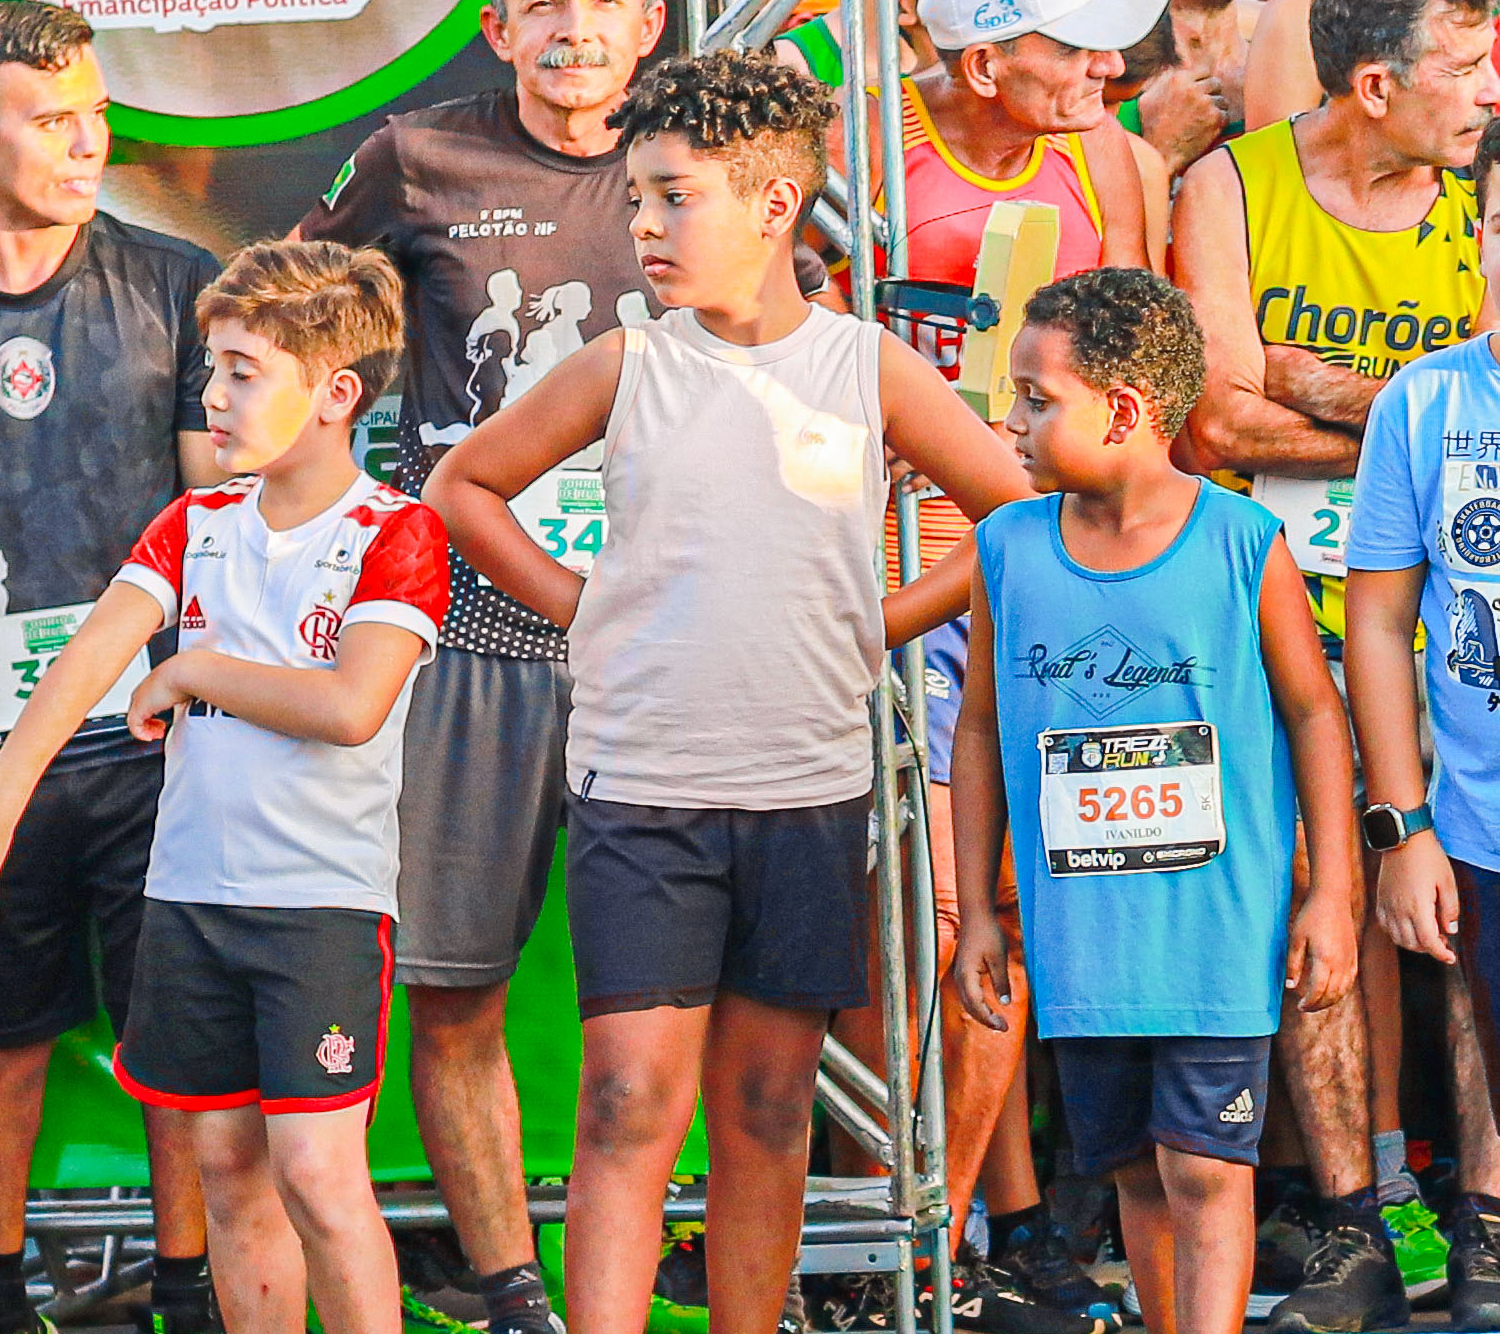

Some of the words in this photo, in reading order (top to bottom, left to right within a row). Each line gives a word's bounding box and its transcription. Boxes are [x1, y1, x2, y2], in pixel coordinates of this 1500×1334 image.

[448, 220, 528, 239] PELOTÃO
[1309, 508, 1346, 548] 2
[11, 656, 59, 700] 3
[1102, 647, 1198, 691] Legends
[1101, 734, 1172, 753] TREZE
[1102, 751, 1151, 769] RUN
[1078, 782, 1184, 823] 5265
[1104, 826, 1163, 841] IVANILDO
[1066, 848, 1127, 871] betvip
